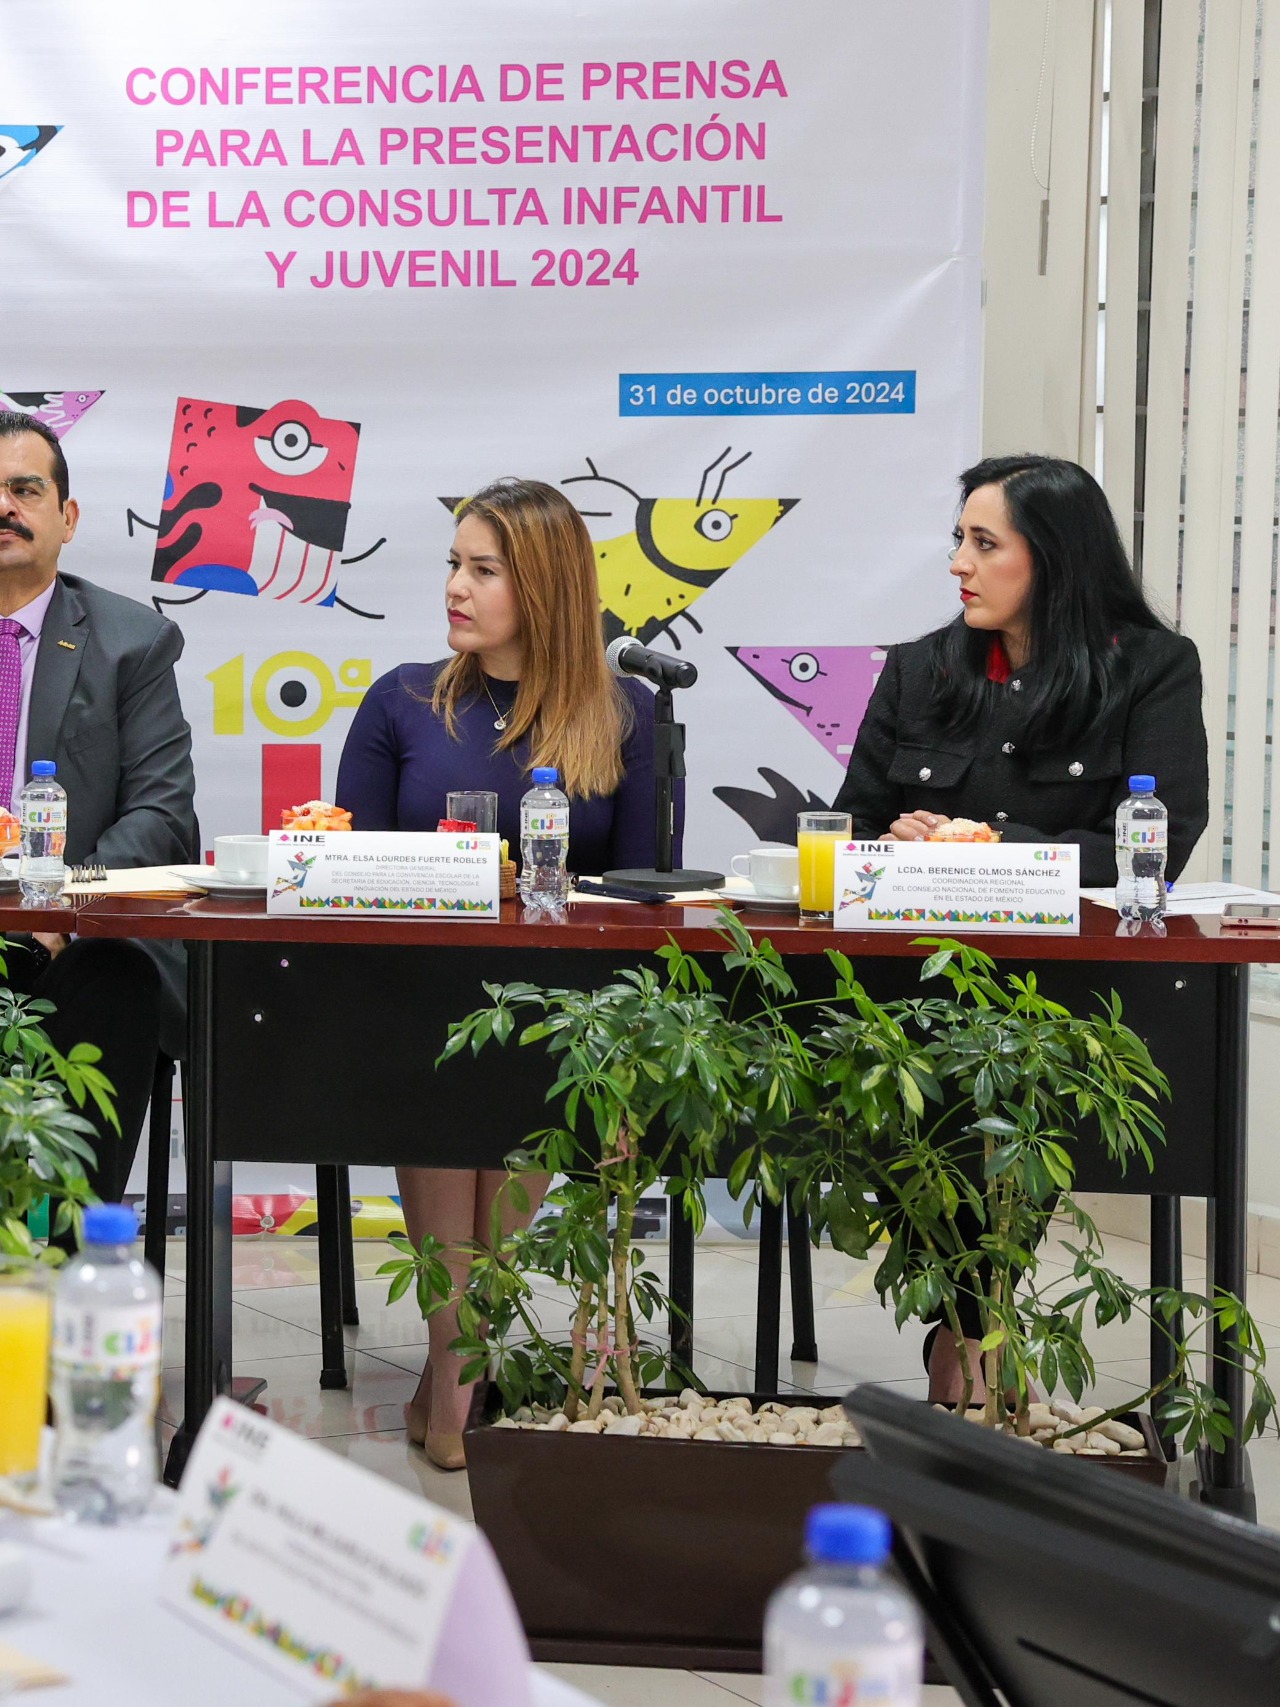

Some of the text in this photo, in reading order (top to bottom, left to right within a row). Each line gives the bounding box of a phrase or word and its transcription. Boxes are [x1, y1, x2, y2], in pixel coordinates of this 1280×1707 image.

[127, 59, 788, 106] CONFERENCIA DE PRENSA
[156, 113, 766, 167] PARA LA PRESENTACIÓN
[127, 184, 783, 228] DE LA CONSULTA INFANTIL
[266, 248, 640, 289] Y JUVENIL 2024
[629, 382, 905, 406] 31 de octubre de 2024
[28, 811, 50, 824] CIJ
[530, 818, 554, 830] CIJ
[293, 834, 326, 843] INE
[1131, 831, 1156, 843] CIJ
[456, 840, 478, 850] CIJ
[861, 844, 894, 852] INE
[325, 854, 350, 862] MTRA.
[1034, 850, 1057, 861] CIJ
[897, 866, 1061, 877] LCDA. BERENICE OLMOS SÁNCHEZ
